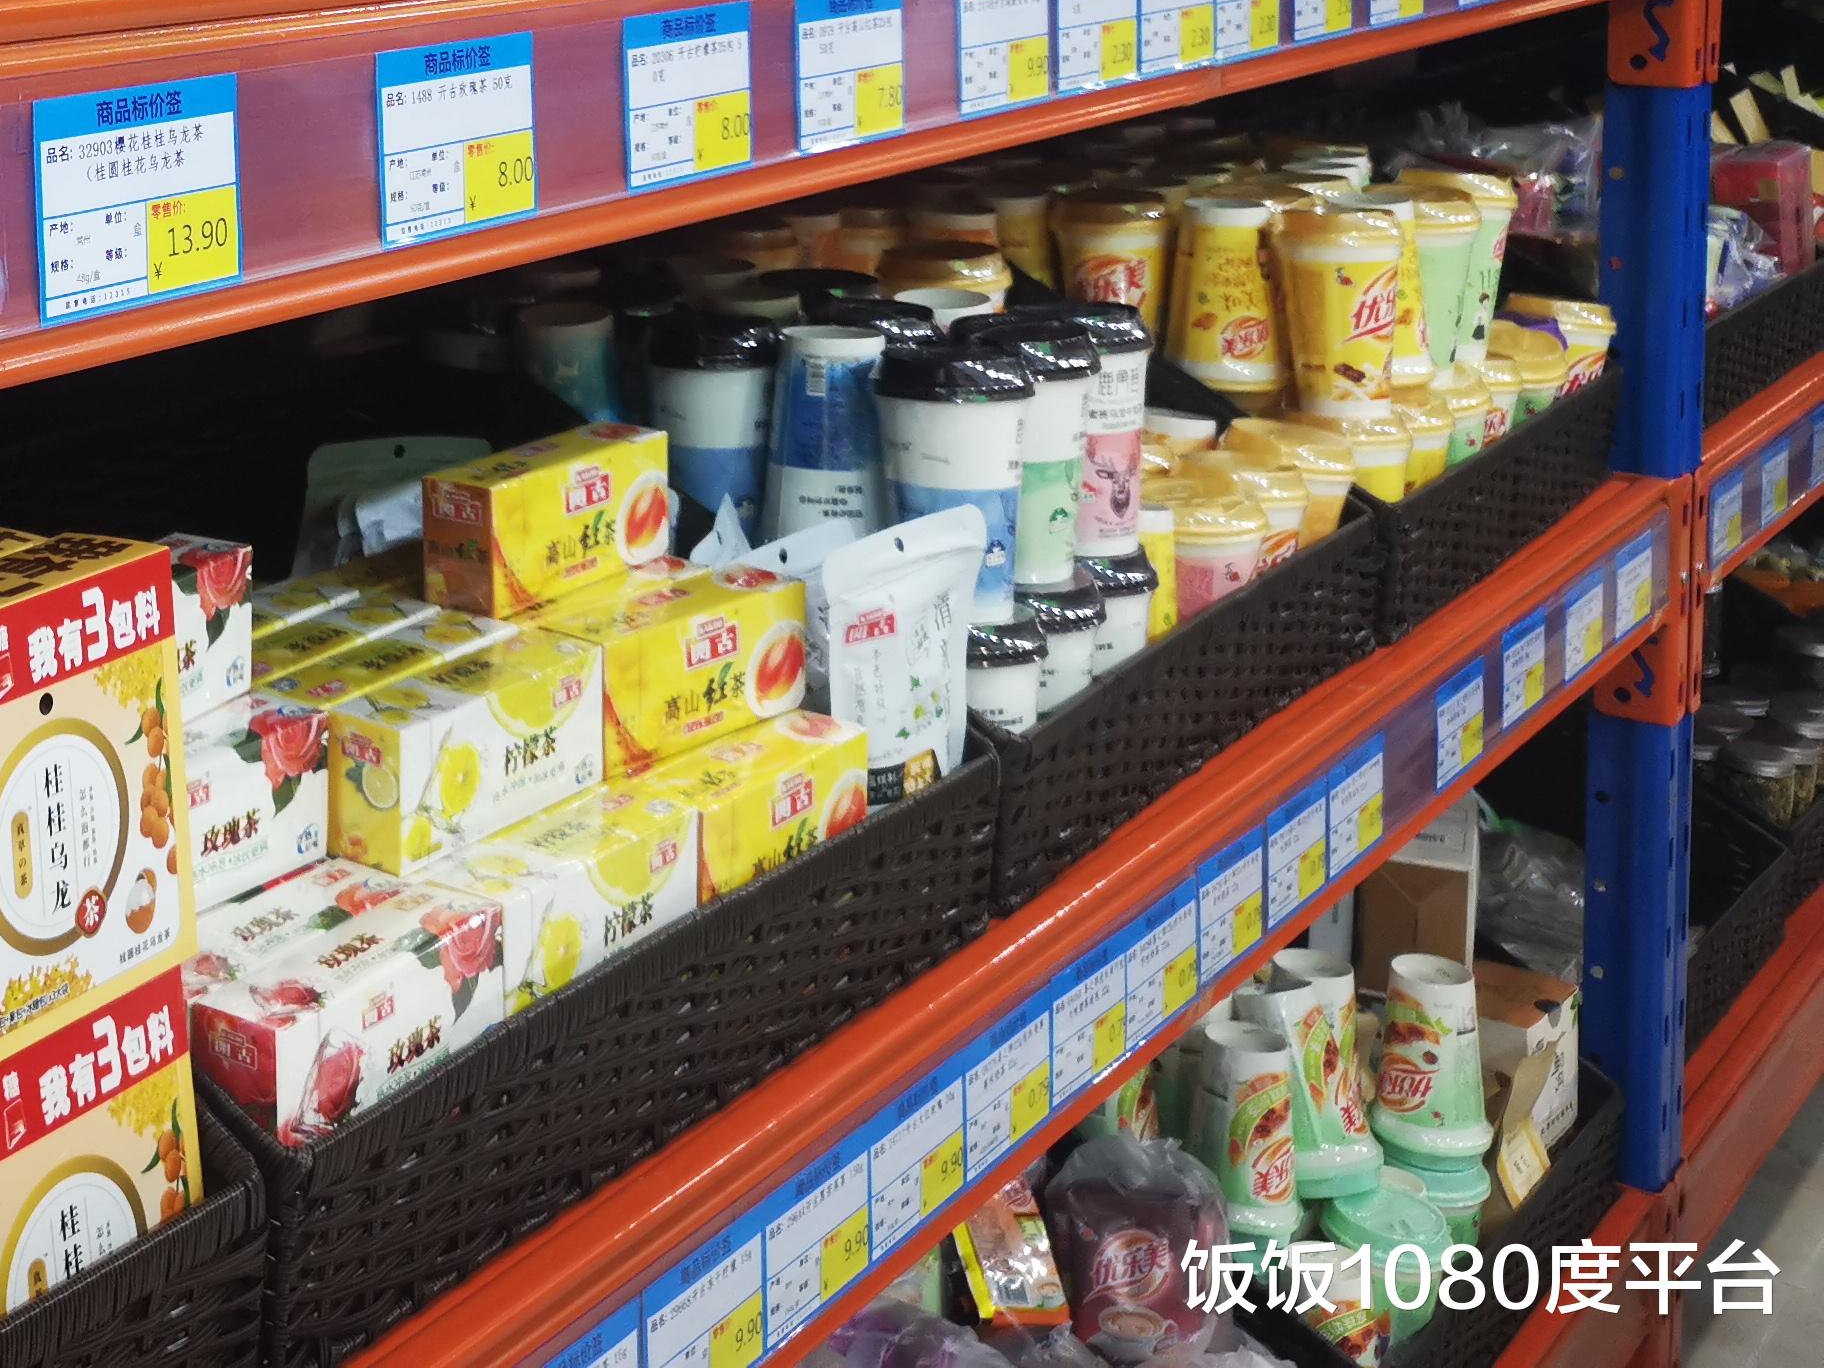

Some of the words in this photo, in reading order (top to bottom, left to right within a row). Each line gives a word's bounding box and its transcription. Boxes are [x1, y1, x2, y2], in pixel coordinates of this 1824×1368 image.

[424, 45, 491, 76] 商品标价签
[96, 90, 183, 127] 商品标价签
[386, 92, 408, 107] 品名:
[721, 112, 750, 141] 8.00
[46, 147, 73, 164] 品名:
[498, 156, 534, 187] 8.00
[151, 201, 186, 219] 零售价:
[168, 218, 227, 256] 13.90
[543, 523, 617, 567] 高山红茶
[27, 586, 161, 684] 我有3包料
[662, 671, 746, 721] 高山红茶
[503, 727, 558, 777] 柠檬茶
[43, 763, 73, 914] 桂桂乌龙
[200, 807, 262, 858] 玫瑰茶
[82, 896, 101, 926] 茶
[602, 893, 654, 946] 柠檬茶
[386, 1014, 443, 1070] 玫瑰茶
[38, 1004, 175, 1126] 我有3包料
[843, 1223, 869, 1261] 9.90
[1089, 1238, 1173, 1291] 优乐美
[735, 1310, 763, 1351] 9.90
